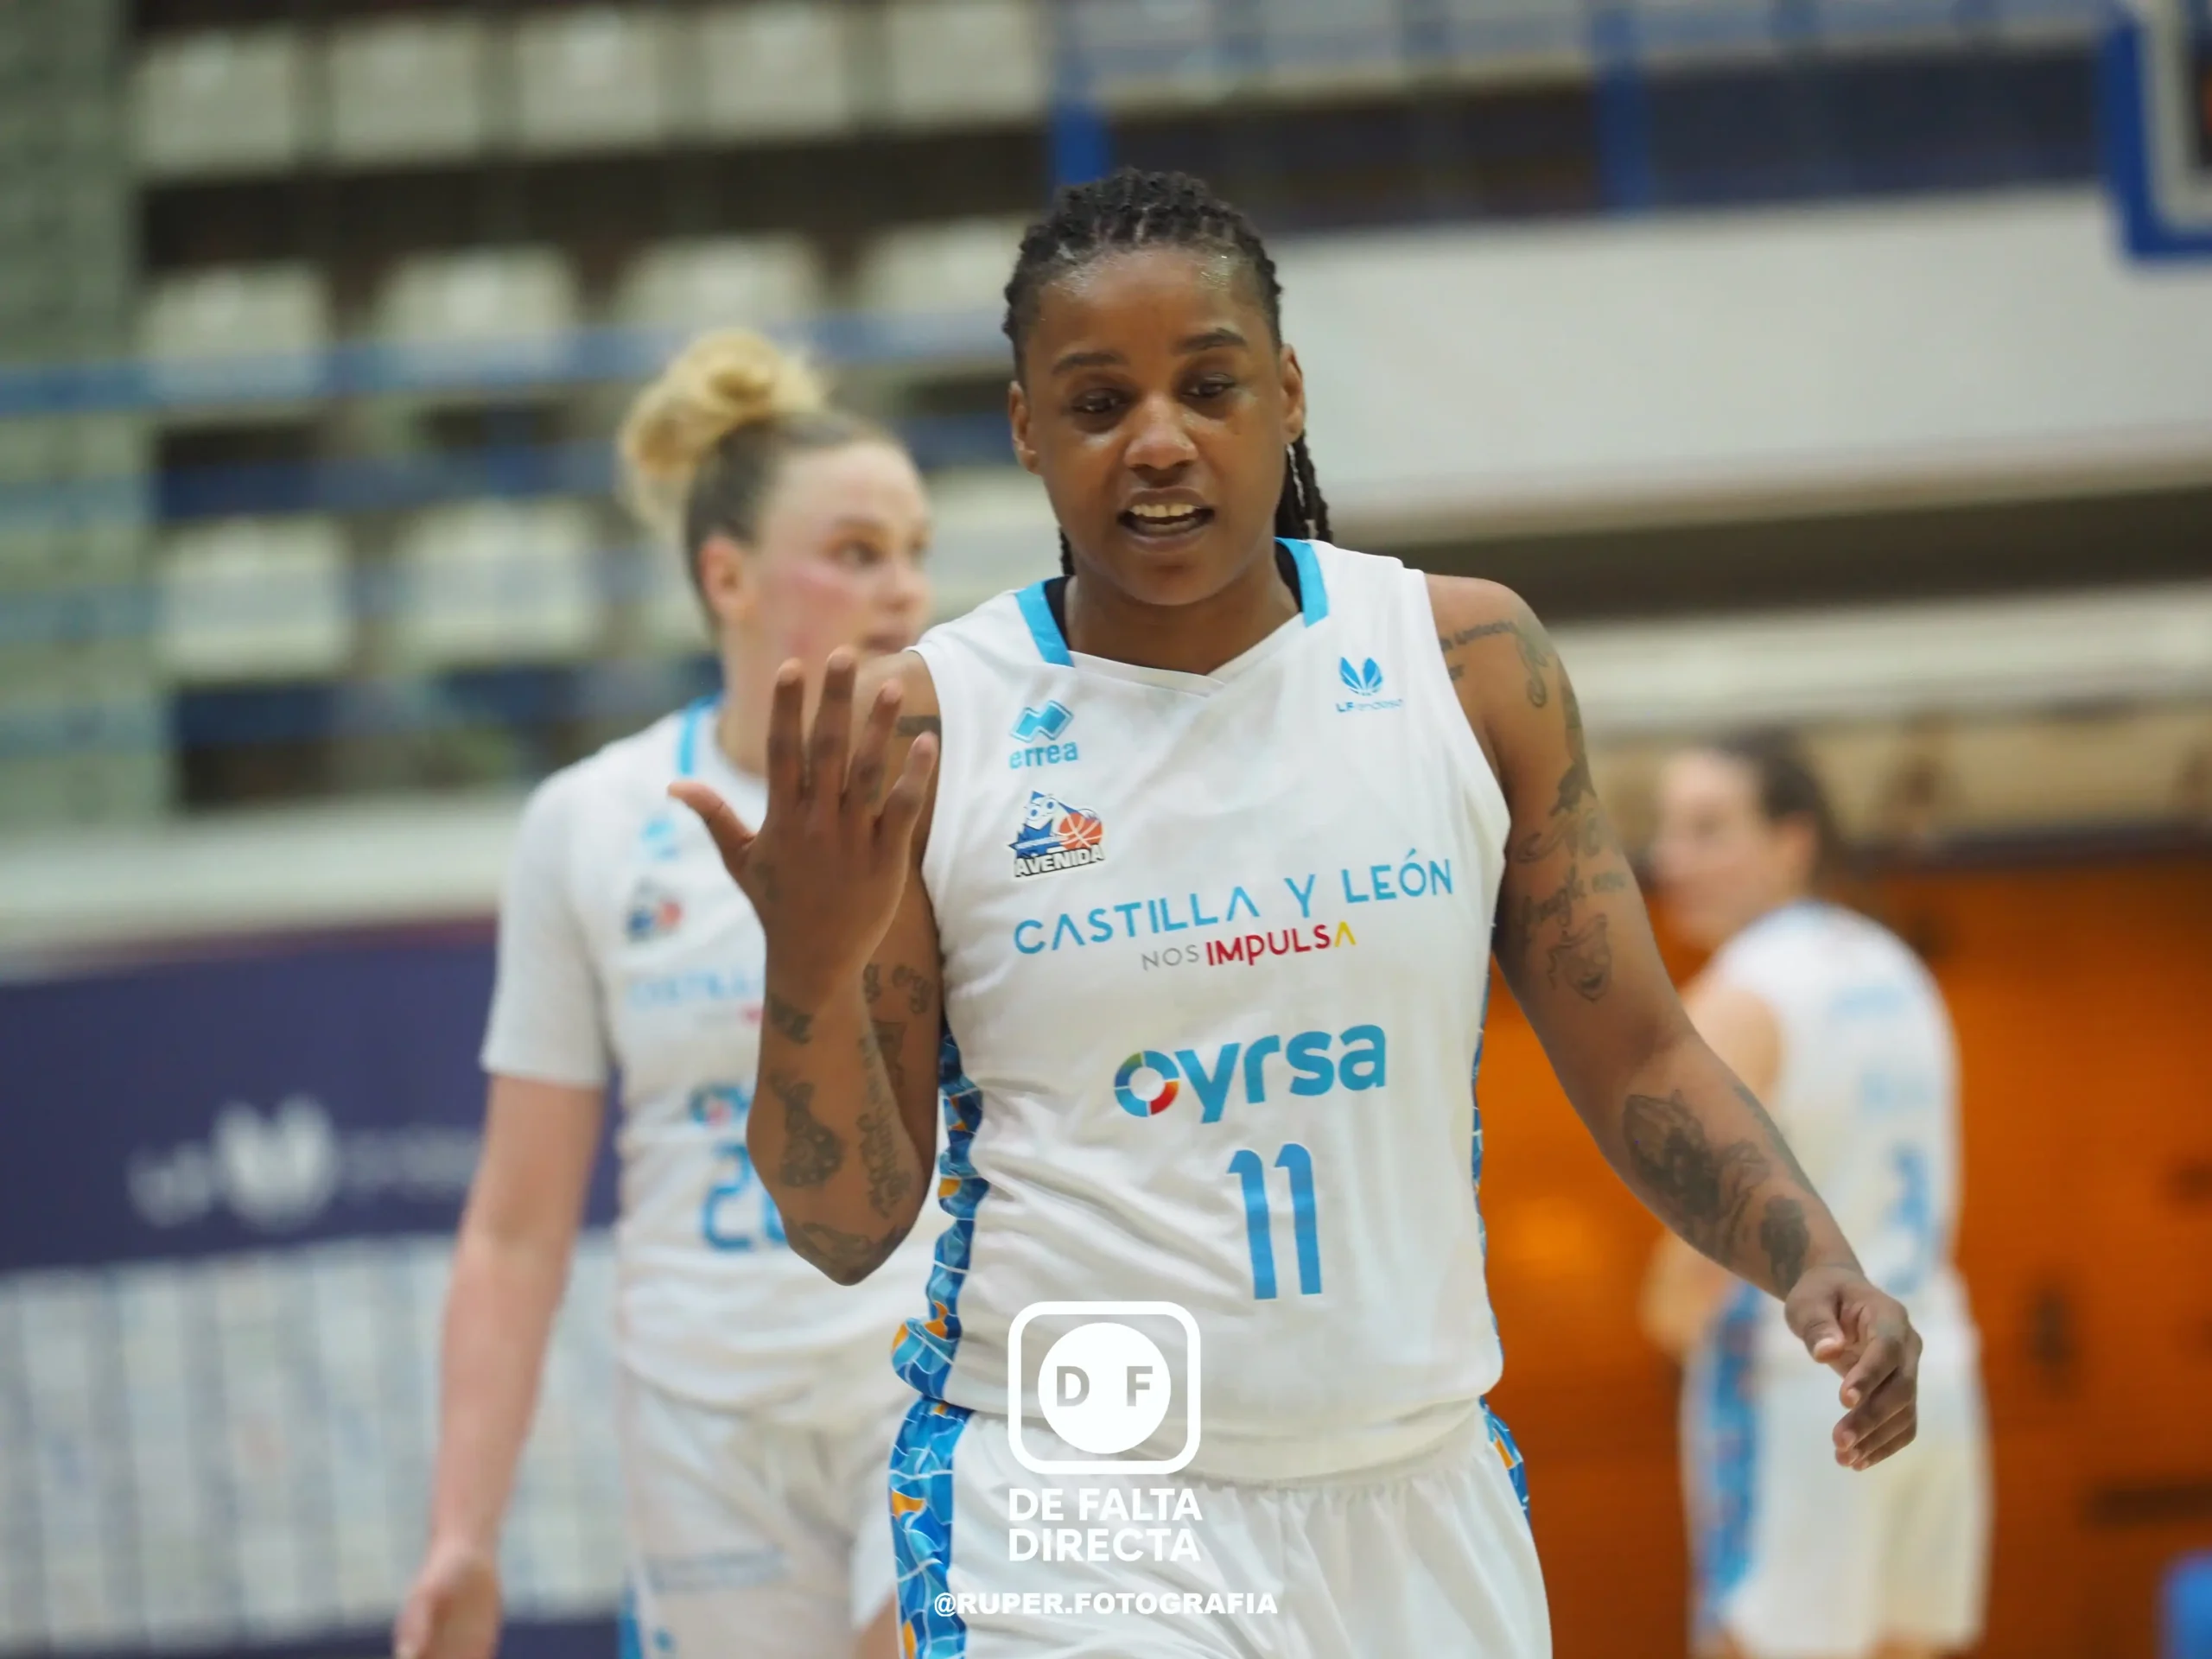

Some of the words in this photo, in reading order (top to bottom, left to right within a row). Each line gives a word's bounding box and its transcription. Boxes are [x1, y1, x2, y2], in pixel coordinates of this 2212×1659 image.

[1014, 842, 1105, 877] AVENIDA
[1014, 886, 1260, 954] CASTILLA
[1284, 874, 1316, 918] Y
[1341, 849, 1453, 904] LEÓN
[1141, 944, 1199, 971] NOS
[1205, 921, 1357, 966] IMPULSA
[1226, 1142, 1322, 1300] 11
